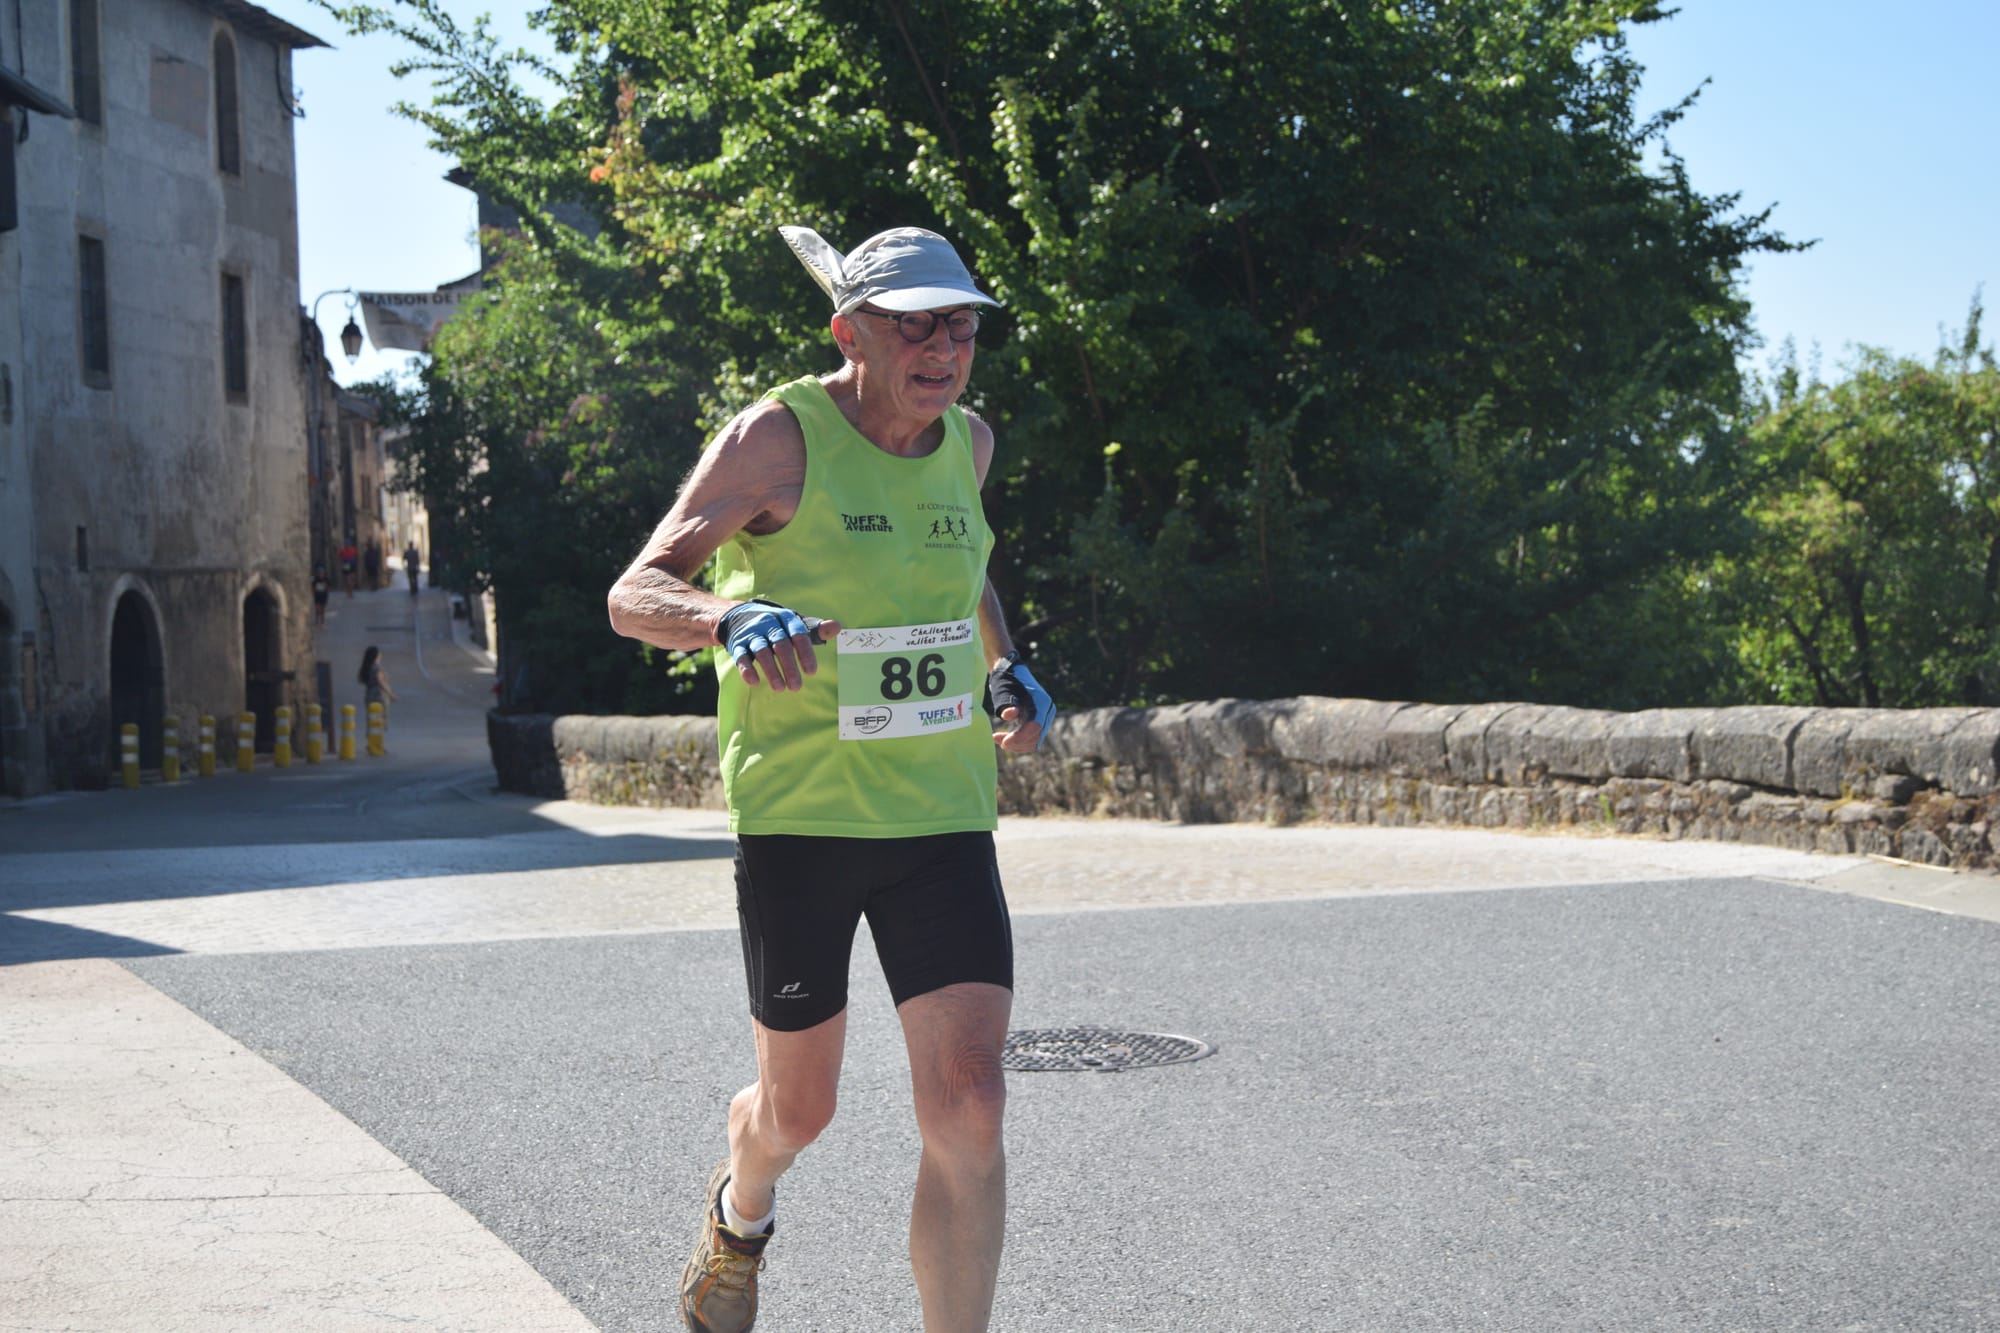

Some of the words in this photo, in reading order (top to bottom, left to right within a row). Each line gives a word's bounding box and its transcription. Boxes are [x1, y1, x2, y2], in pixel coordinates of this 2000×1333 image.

[841, 513, 888, 525] TUFF'S
[911, 626, 952, 637] Challenge
[880, 653, 946, 701] 86
[918, 707, 954, 720] TUFF'S
[854, 715, 887, 726] BFP
